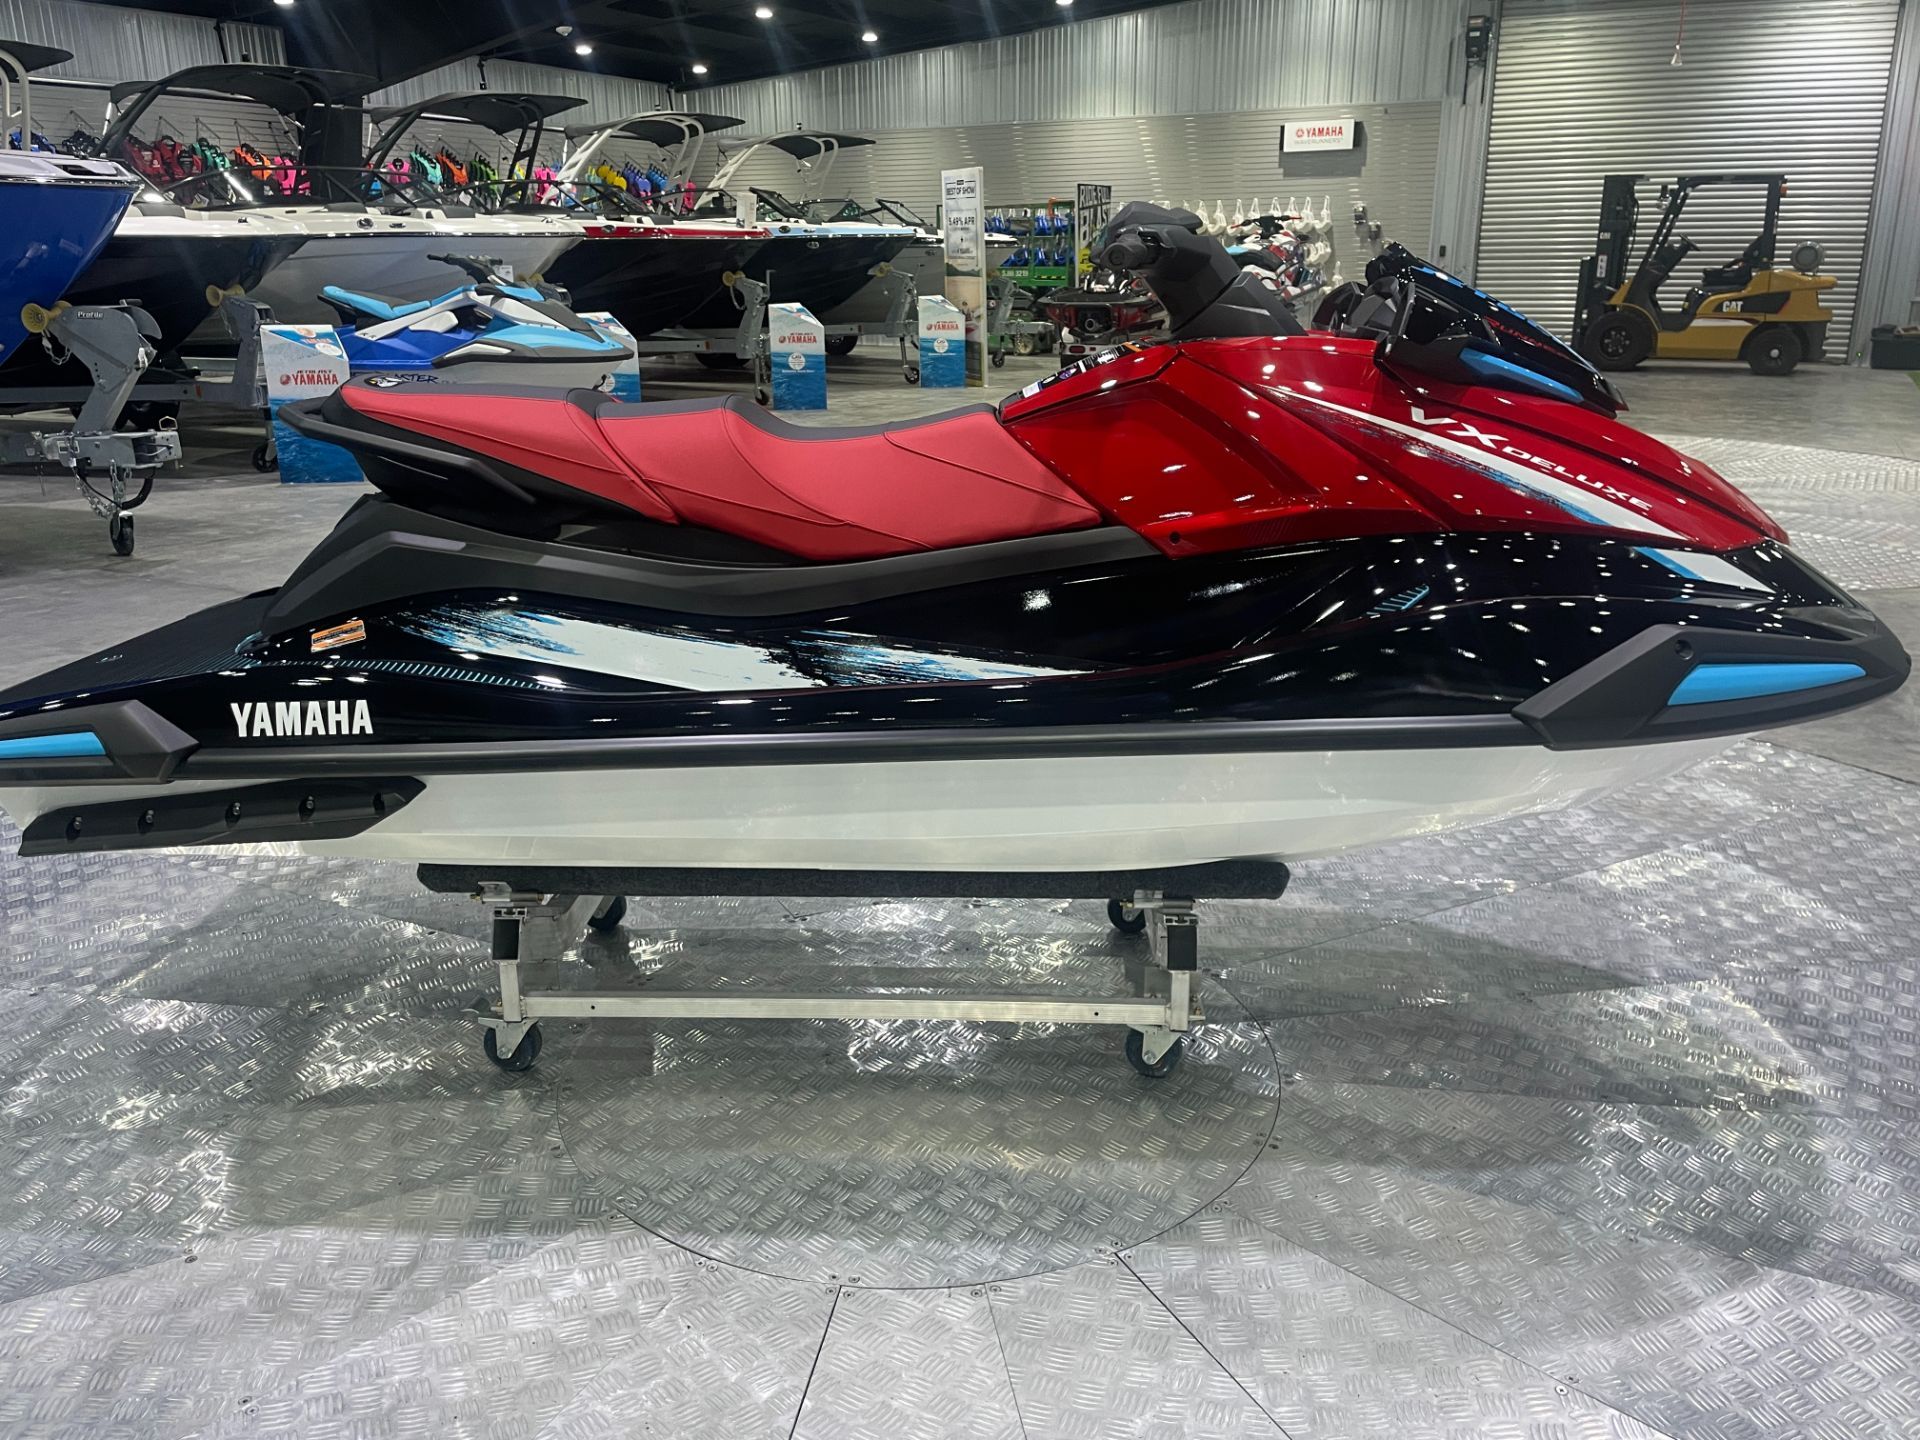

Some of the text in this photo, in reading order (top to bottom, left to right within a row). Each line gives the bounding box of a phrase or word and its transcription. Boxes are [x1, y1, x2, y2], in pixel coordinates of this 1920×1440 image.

[1306, 126, 1344, 138] YAMAHA
[1080, 185, 1097, 208] RIDE
[1722, 301, 1744, 313] CAT
[787, 335, 817, 343] YAMAHA
[291, 373, 339, 385] YAMAHA
[1411, 406, 1653, 511] VX DELUXE
[230, 699, 374, 738] YAMAHA
